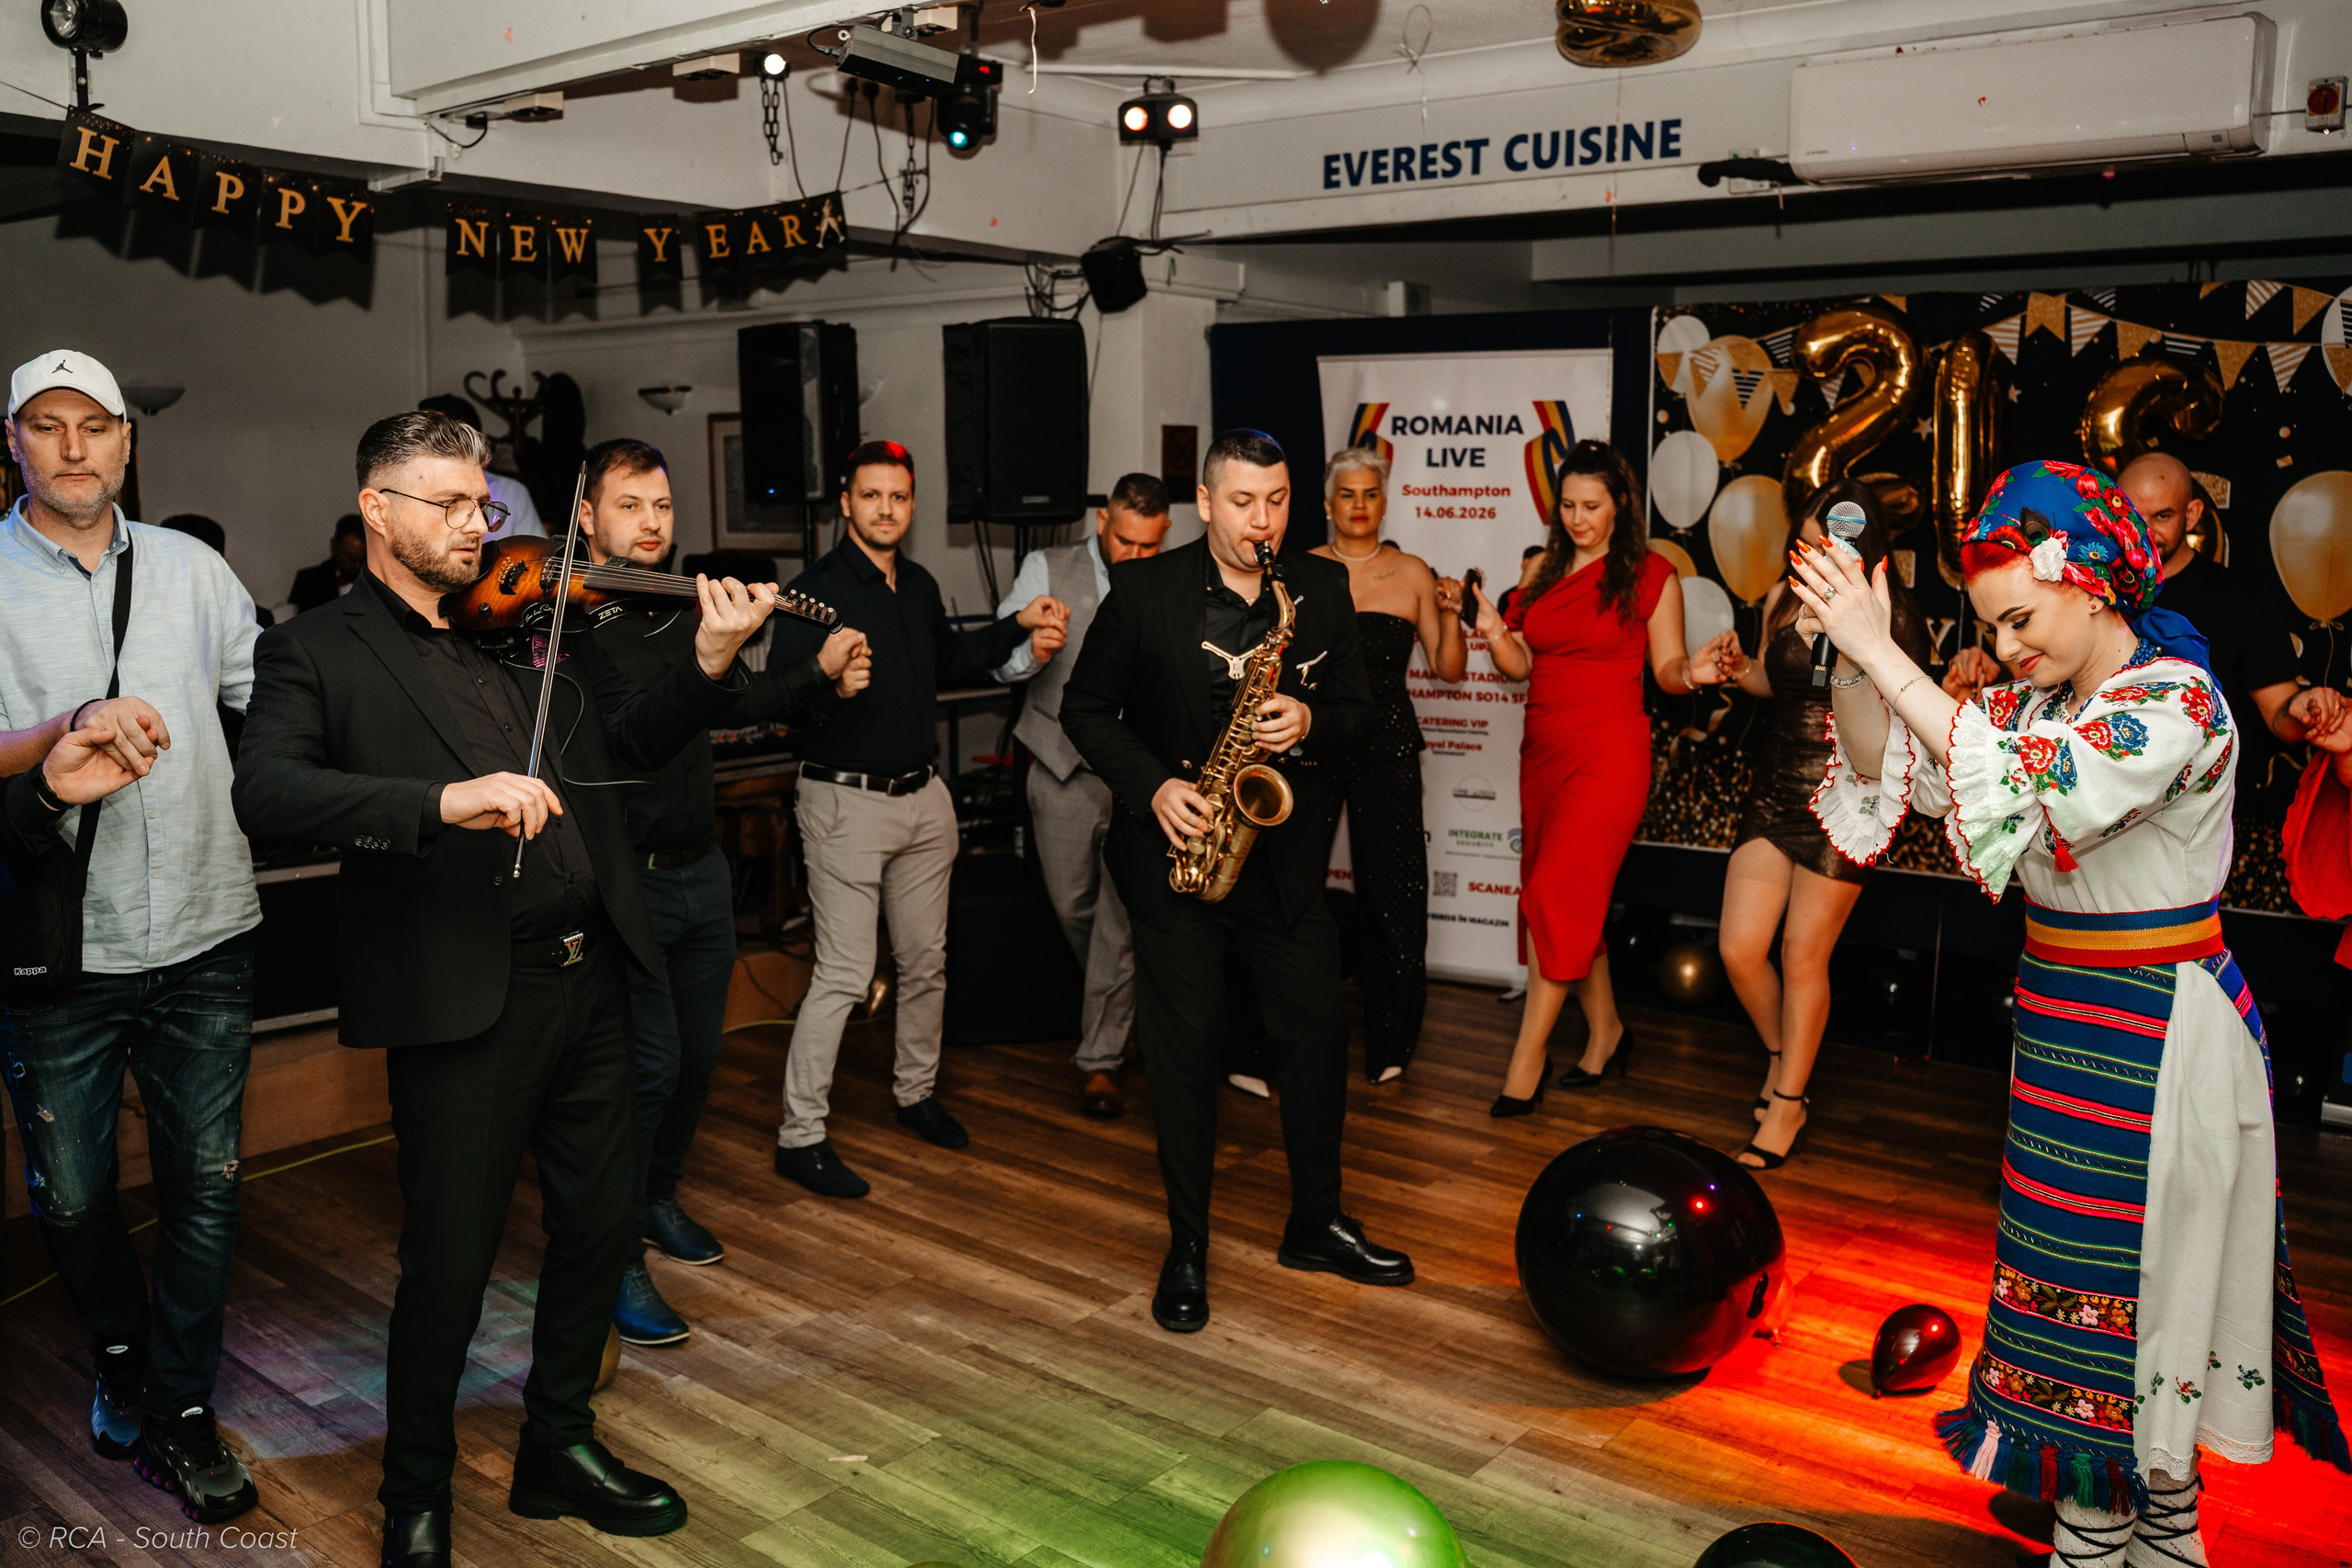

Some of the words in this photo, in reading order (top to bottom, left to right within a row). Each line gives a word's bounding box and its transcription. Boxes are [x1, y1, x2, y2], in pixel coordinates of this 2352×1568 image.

[1323, 138, 1490, 189] EVEREST
[1503, 118, 1682, 172] CUISINE
[69, 125, 368, 243] HAPPY
[455, 219, 589, 263] NEW
[643, 214, 808, 263] YEAR
[1391, 415, 1524, 436] ROMANIA
[1426, 447, 1486, 468] LIVE
[1401, 484, 1511, 499] Southampton
[1415, 507, 1497, 520] 14.06.2026
[597, 606, 623, 620] ZETA
[1408, 687, 1472, 701] HAMPTON
[1470, 719, 1488, 728] VIP
[1425, 739, 1445, 750] oyal
[1448, 740, 1483, 751] Palace
[1448, 829, 1502, 841] INTEGRATE
[1468, 881, 1521, 896] SCANEA
[14, 966, 47, 976] Kappa
